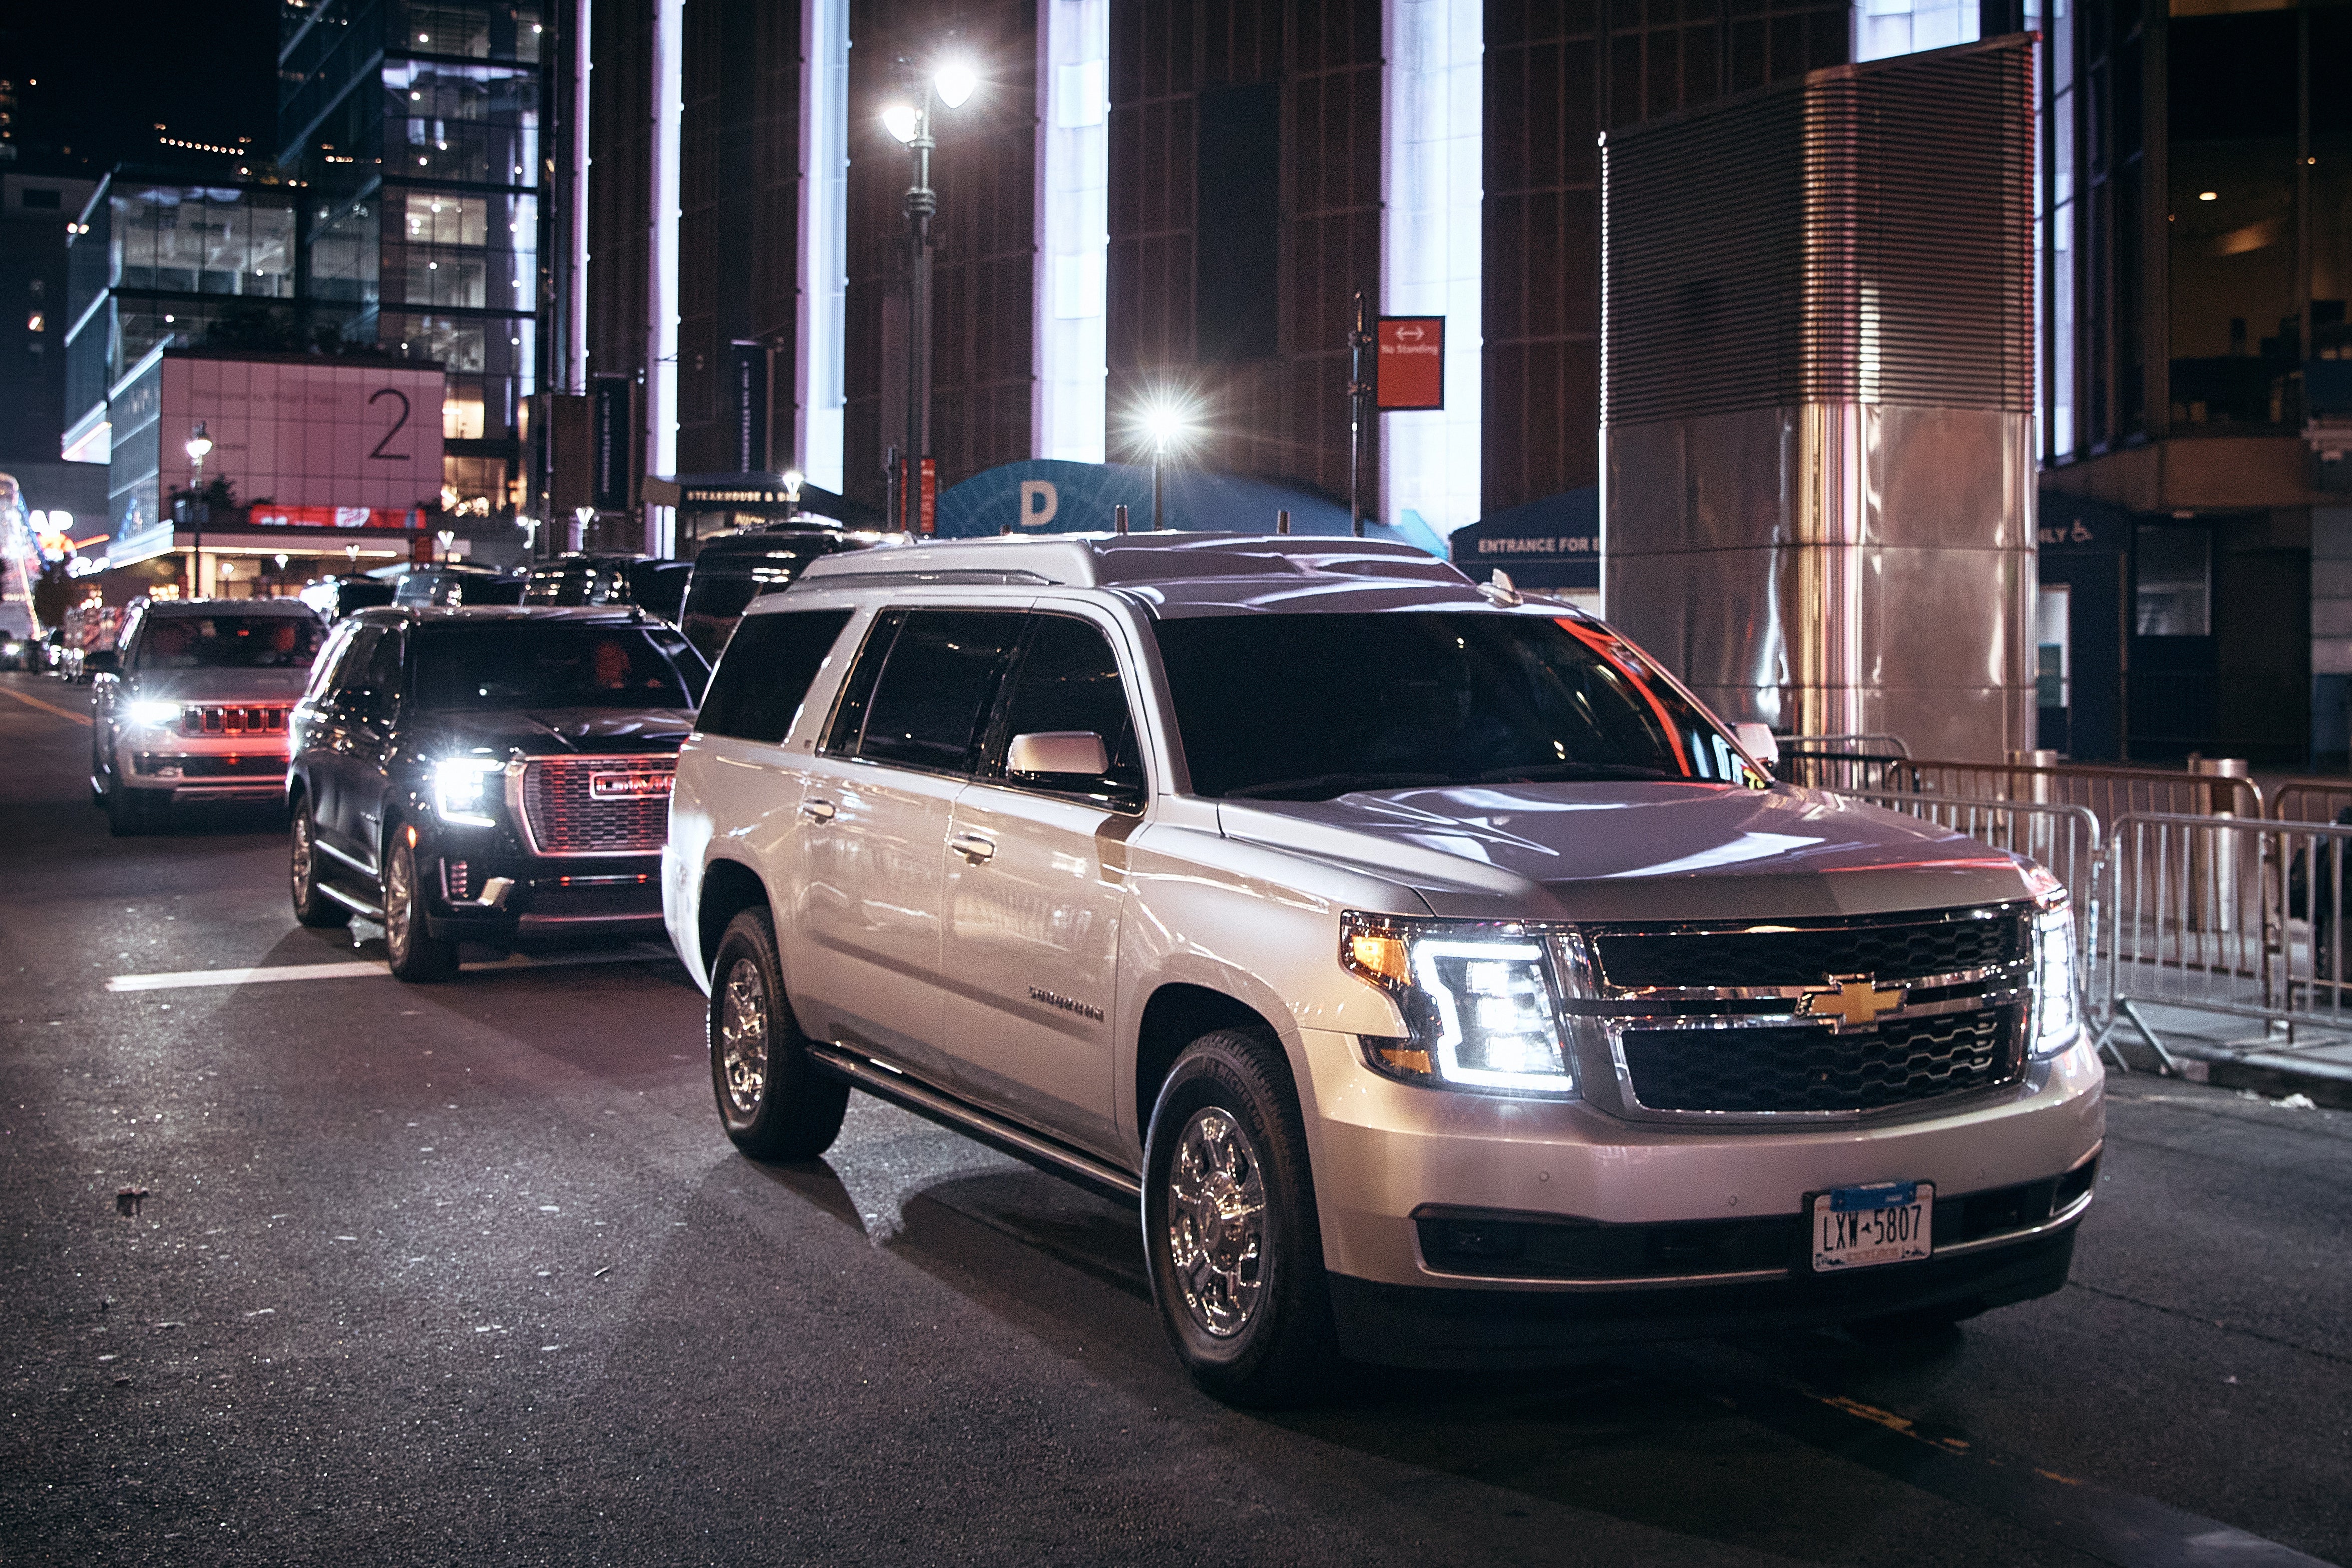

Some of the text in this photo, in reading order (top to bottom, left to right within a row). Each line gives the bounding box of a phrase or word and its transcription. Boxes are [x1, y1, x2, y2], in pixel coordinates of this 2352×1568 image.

[1381, 343, 1439, 355] No Standing
[368, 388, 411, 461] 2
[686, 491, 761, 502] STEAKHOUSE
[1020, 480, 1058, 527] D
[1478, 538, 1555, 553] ENTRANCE
[1558, 537, 1589, 552] FOR
[1874, 1205, 1921, 1245] 5807
